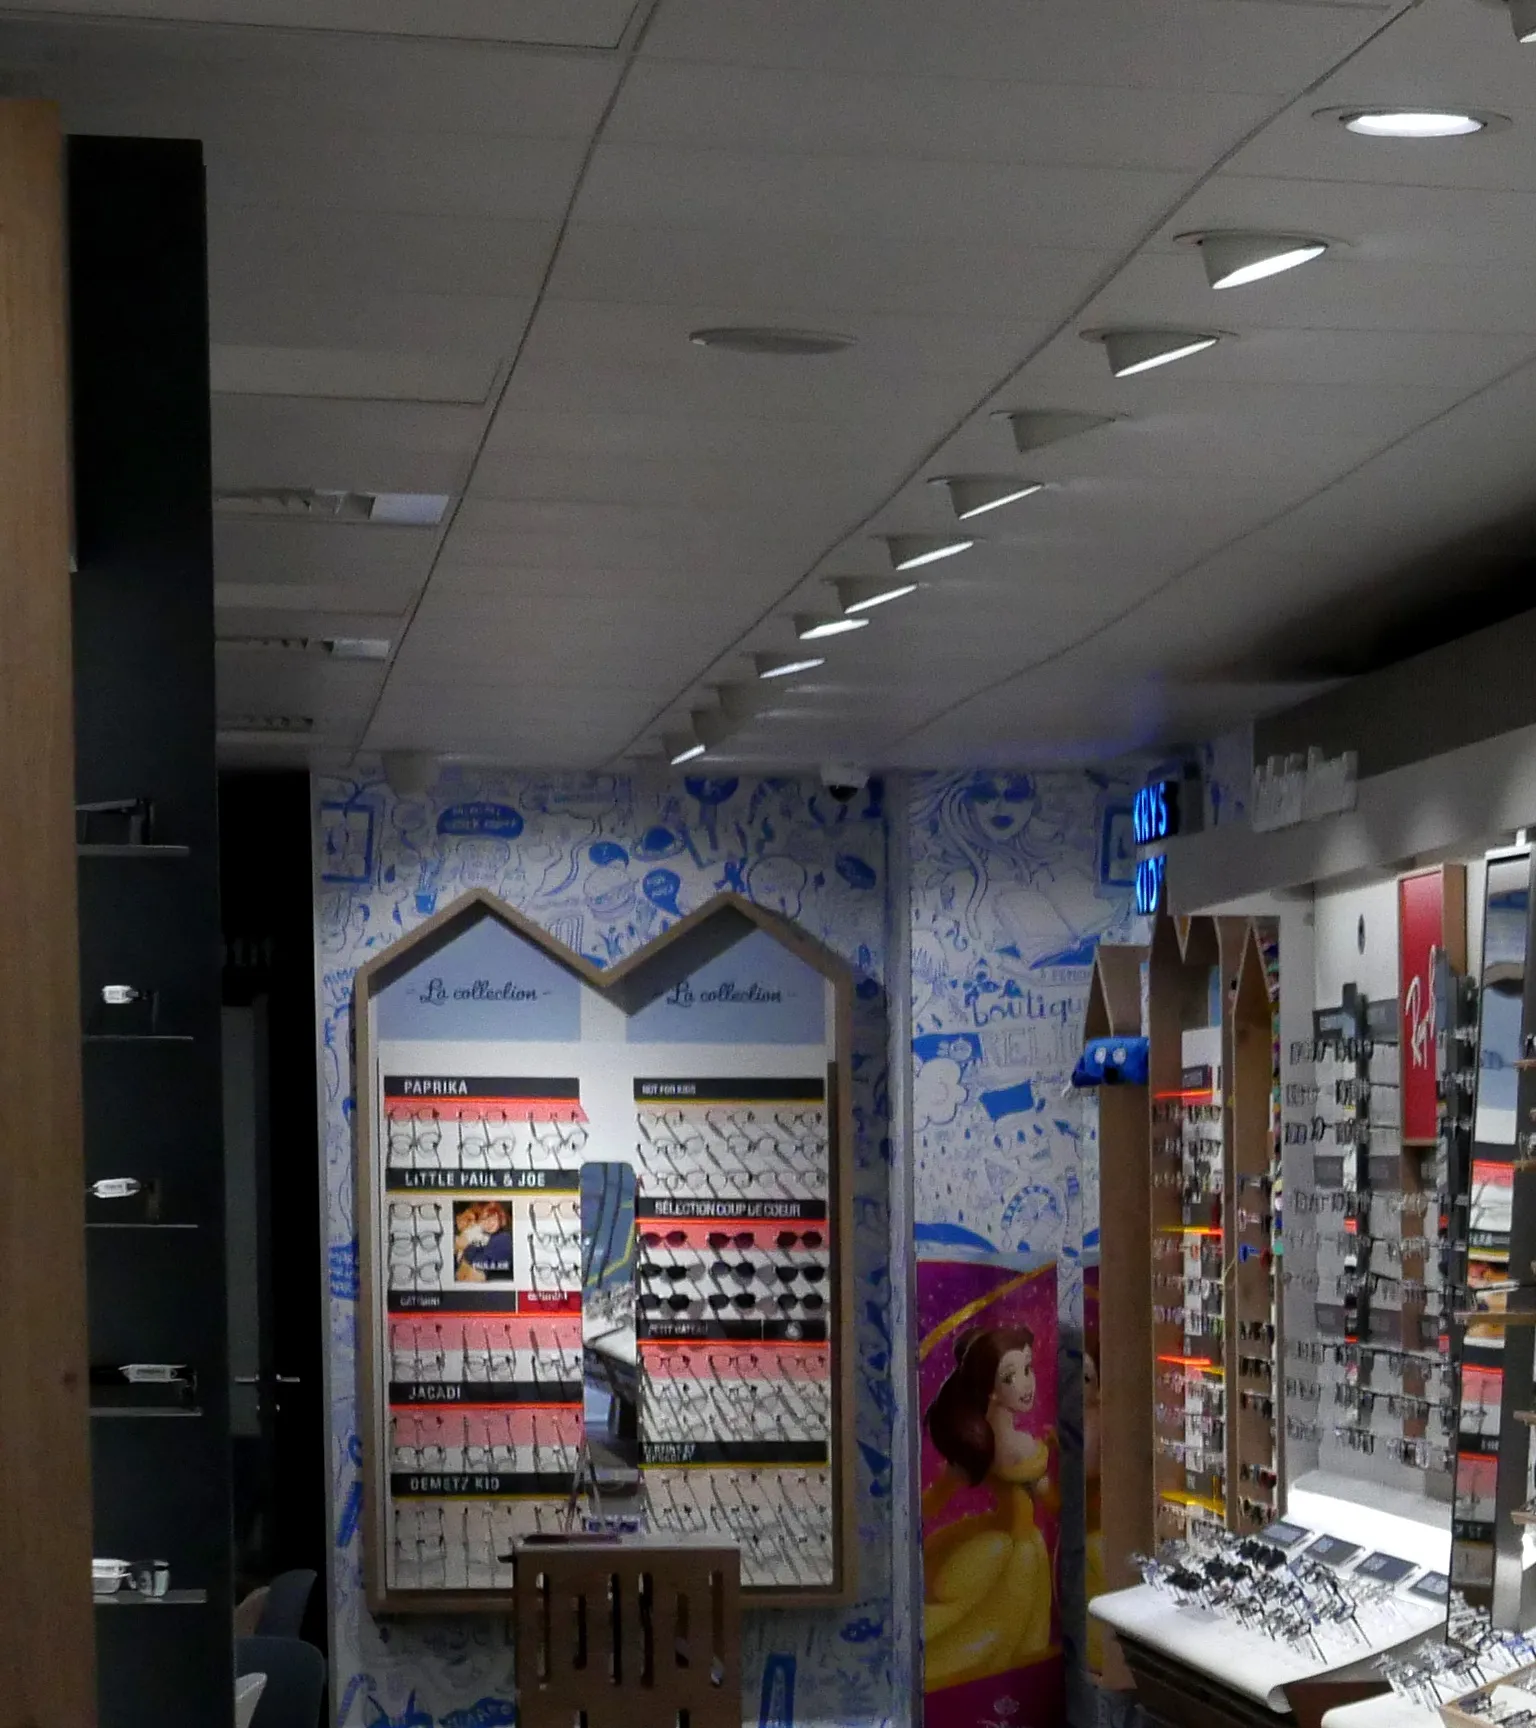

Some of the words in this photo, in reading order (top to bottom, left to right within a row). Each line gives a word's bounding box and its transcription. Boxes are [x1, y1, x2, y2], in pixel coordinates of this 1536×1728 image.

[453, 981, 538, 1001] collection
[699, 983, 782, 1003] collection
[404, 1079, 469, 1096] PAPRIKA
[405, 1171, 455, 1187] LITTLE
[460, 1171, 497, 1187] PAUL
[517, 1171, 546, 1187] JOE
